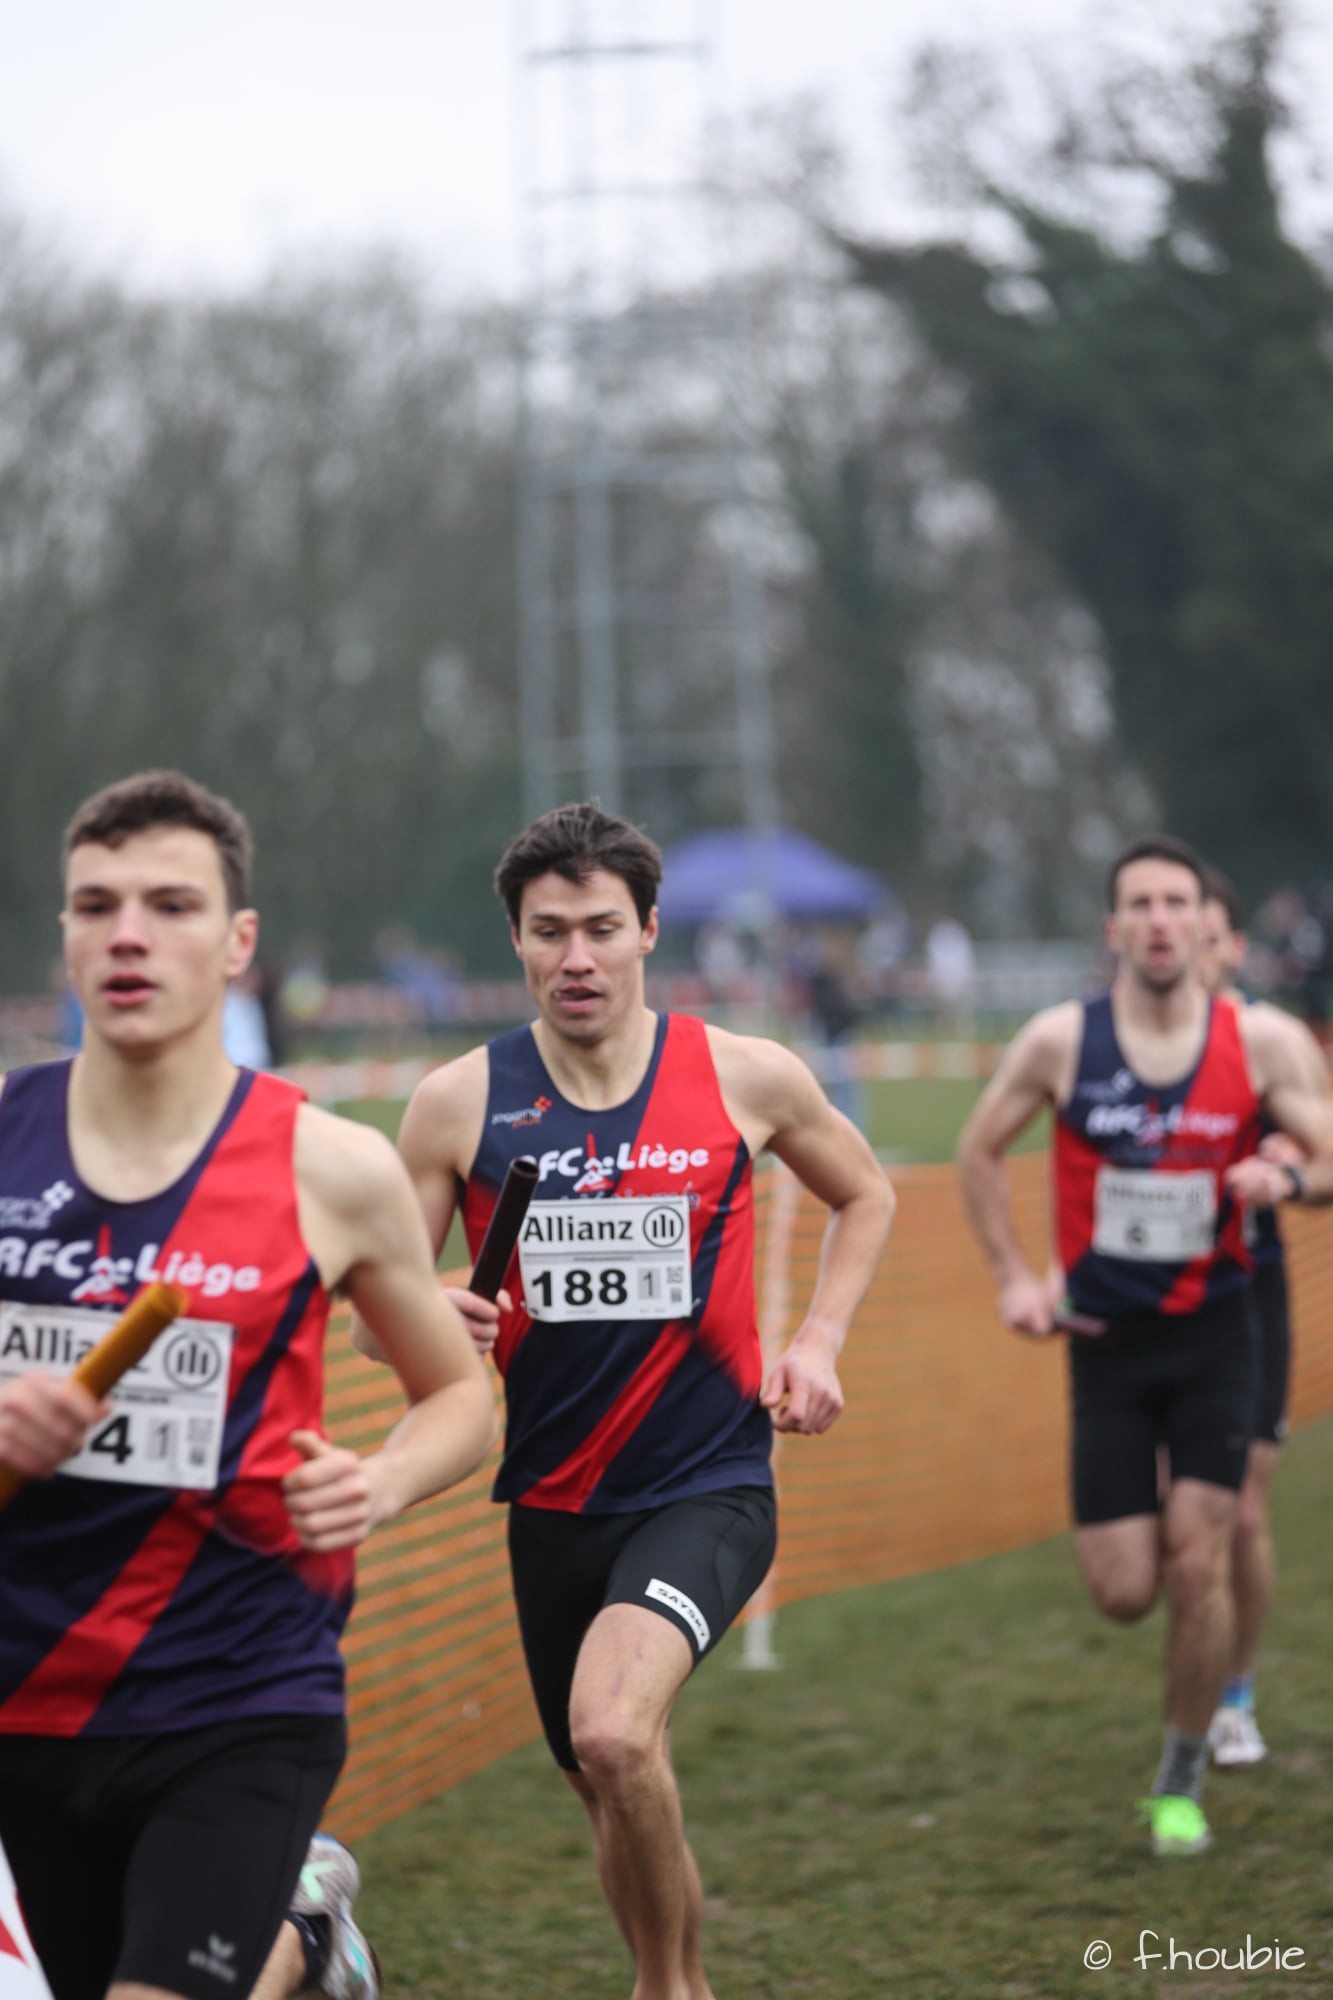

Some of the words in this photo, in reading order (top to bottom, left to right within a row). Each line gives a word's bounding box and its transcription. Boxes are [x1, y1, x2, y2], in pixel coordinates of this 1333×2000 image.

[617, 1142, 709, 1174] Liège
[523, 1214, 634, 1243] Allianz
[0, 1237, 93, 1279] RFC
[134, 1243, 262, 1298] Liège
[532, 1269, 628, 1307] 188
